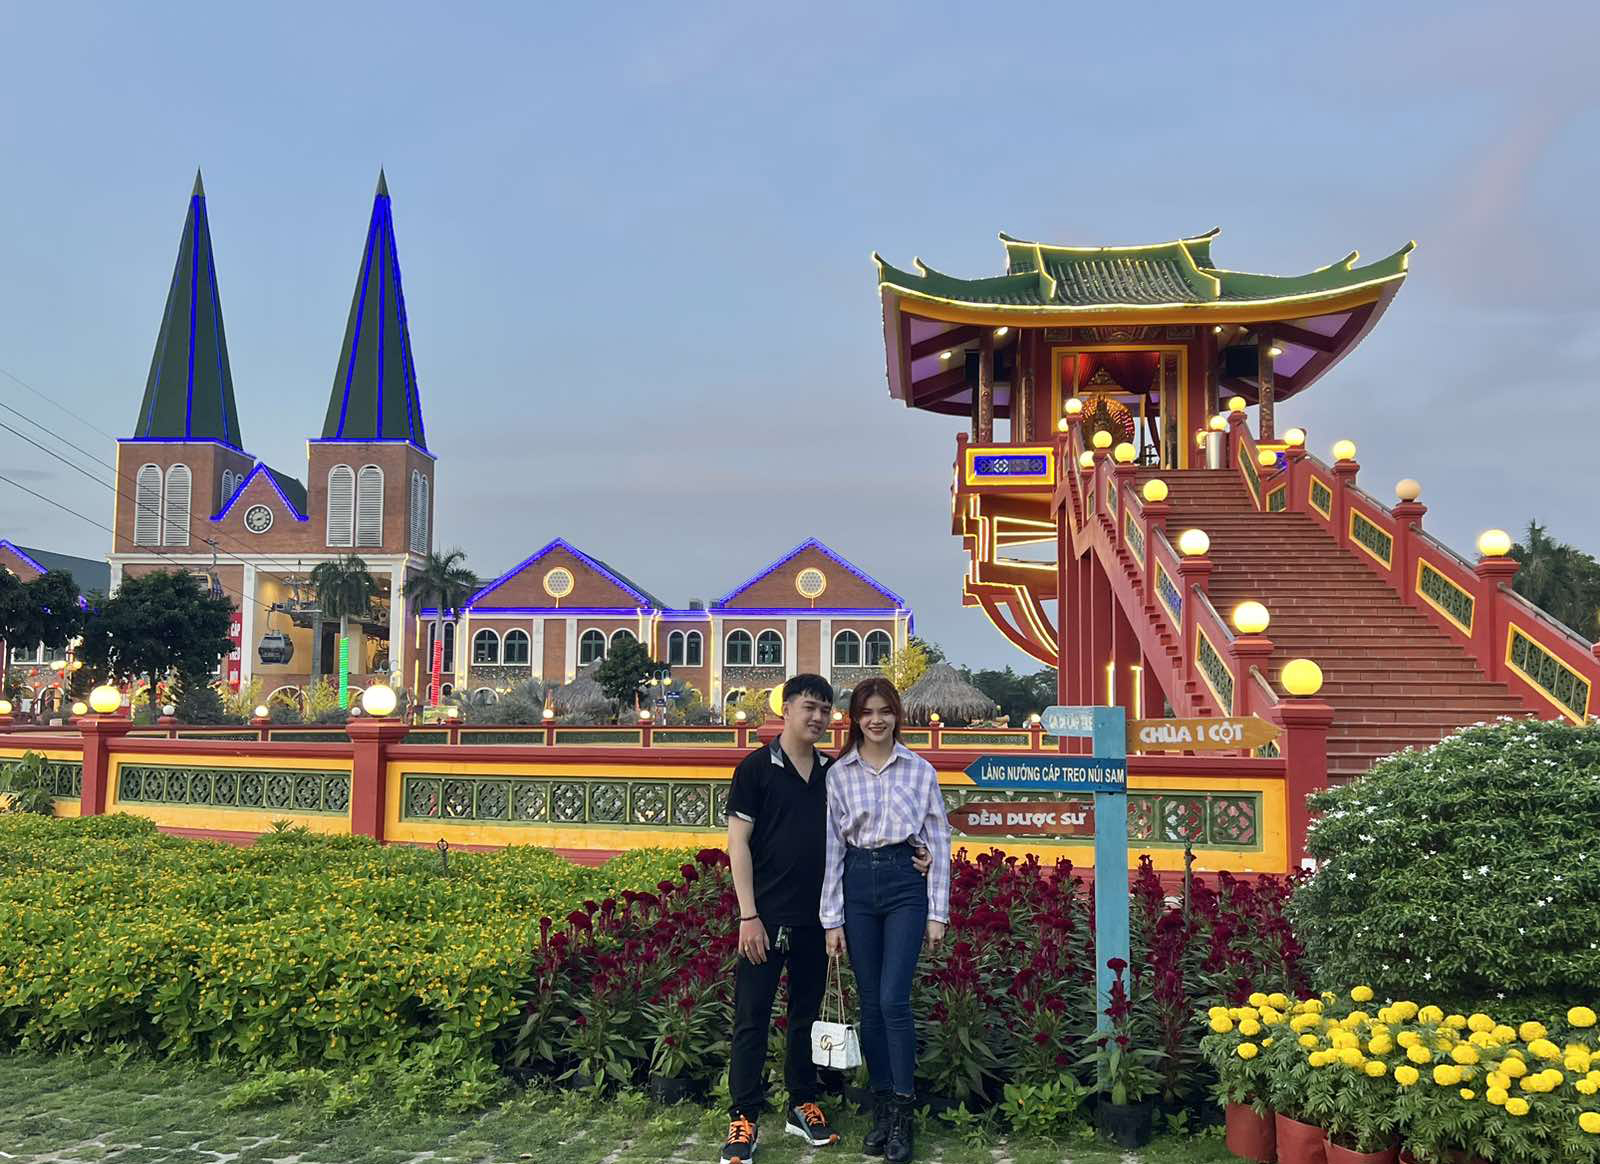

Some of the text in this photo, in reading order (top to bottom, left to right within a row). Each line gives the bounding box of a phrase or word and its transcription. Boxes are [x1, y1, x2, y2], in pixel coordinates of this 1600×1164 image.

[1139, 723, 1192, 743] CHÙA
[1208, 720, 1244, 744] CỘT
[981, 763, 1125, 784] LÀNG NƯỚNG CÁP TREO NÚI SAM
[1006, 811, 1057, 828] DƯỢC
[1060, 812, 1087, 826] SƯ
